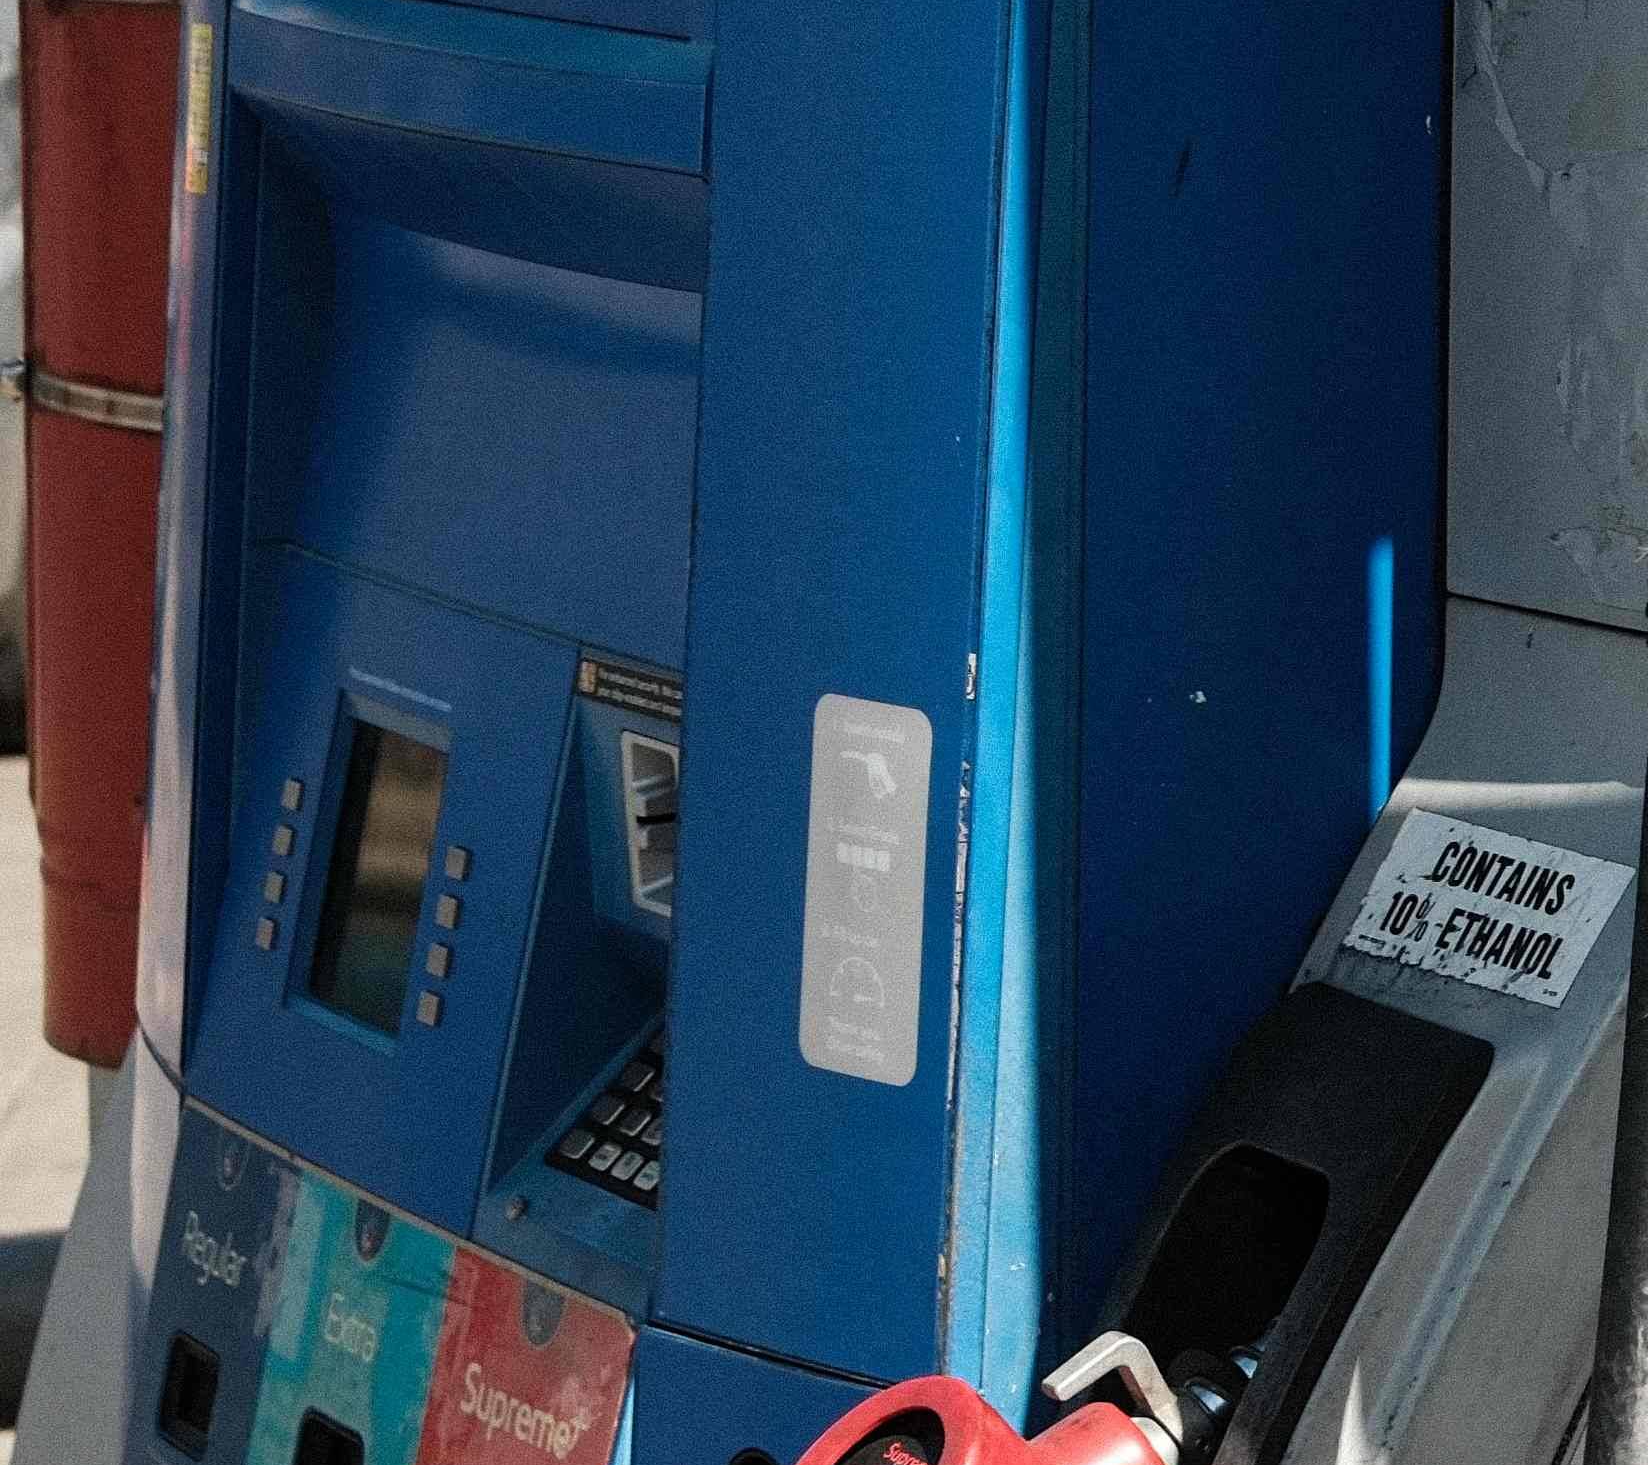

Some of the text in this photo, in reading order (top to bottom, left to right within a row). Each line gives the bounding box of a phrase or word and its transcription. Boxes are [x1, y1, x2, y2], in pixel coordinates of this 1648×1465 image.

[1430, 839, 1576, 915] CONTAINS
[1379, 891, 1564, 980] 10% ETHANOL
[183, 1210, 247, 1286] Regular
[324, 1292, 379, 1363] Extra
